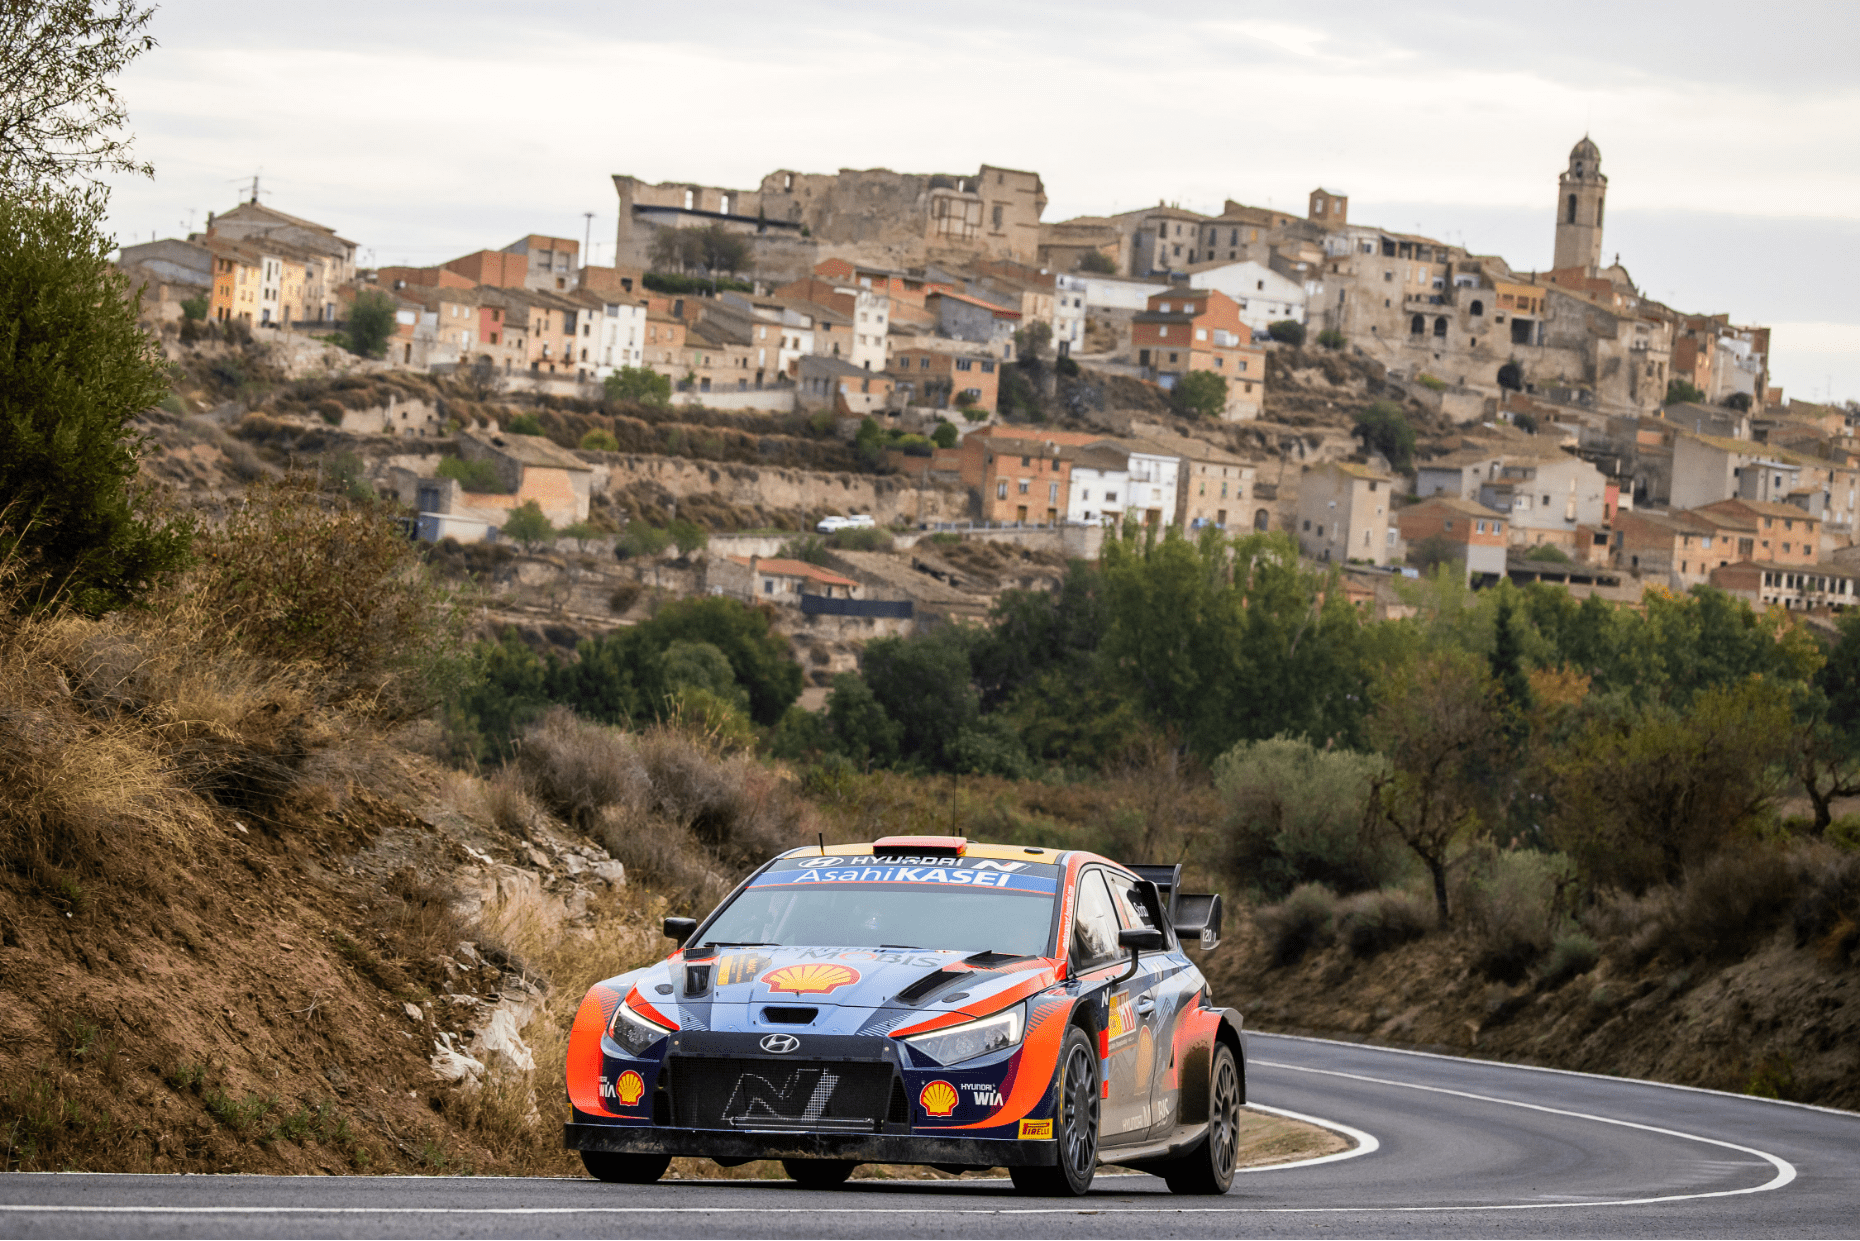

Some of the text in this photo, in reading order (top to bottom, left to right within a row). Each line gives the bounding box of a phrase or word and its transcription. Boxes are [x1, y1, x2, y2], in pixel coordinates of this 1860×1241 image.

[850, 855, 964, 867] HYUNDAI
[798, 950, 942, 968] MOBIS
[960, 1083, 993, 1092] HYUNDAI
[1022, 1123, 1050, 1135] PIRELLI
